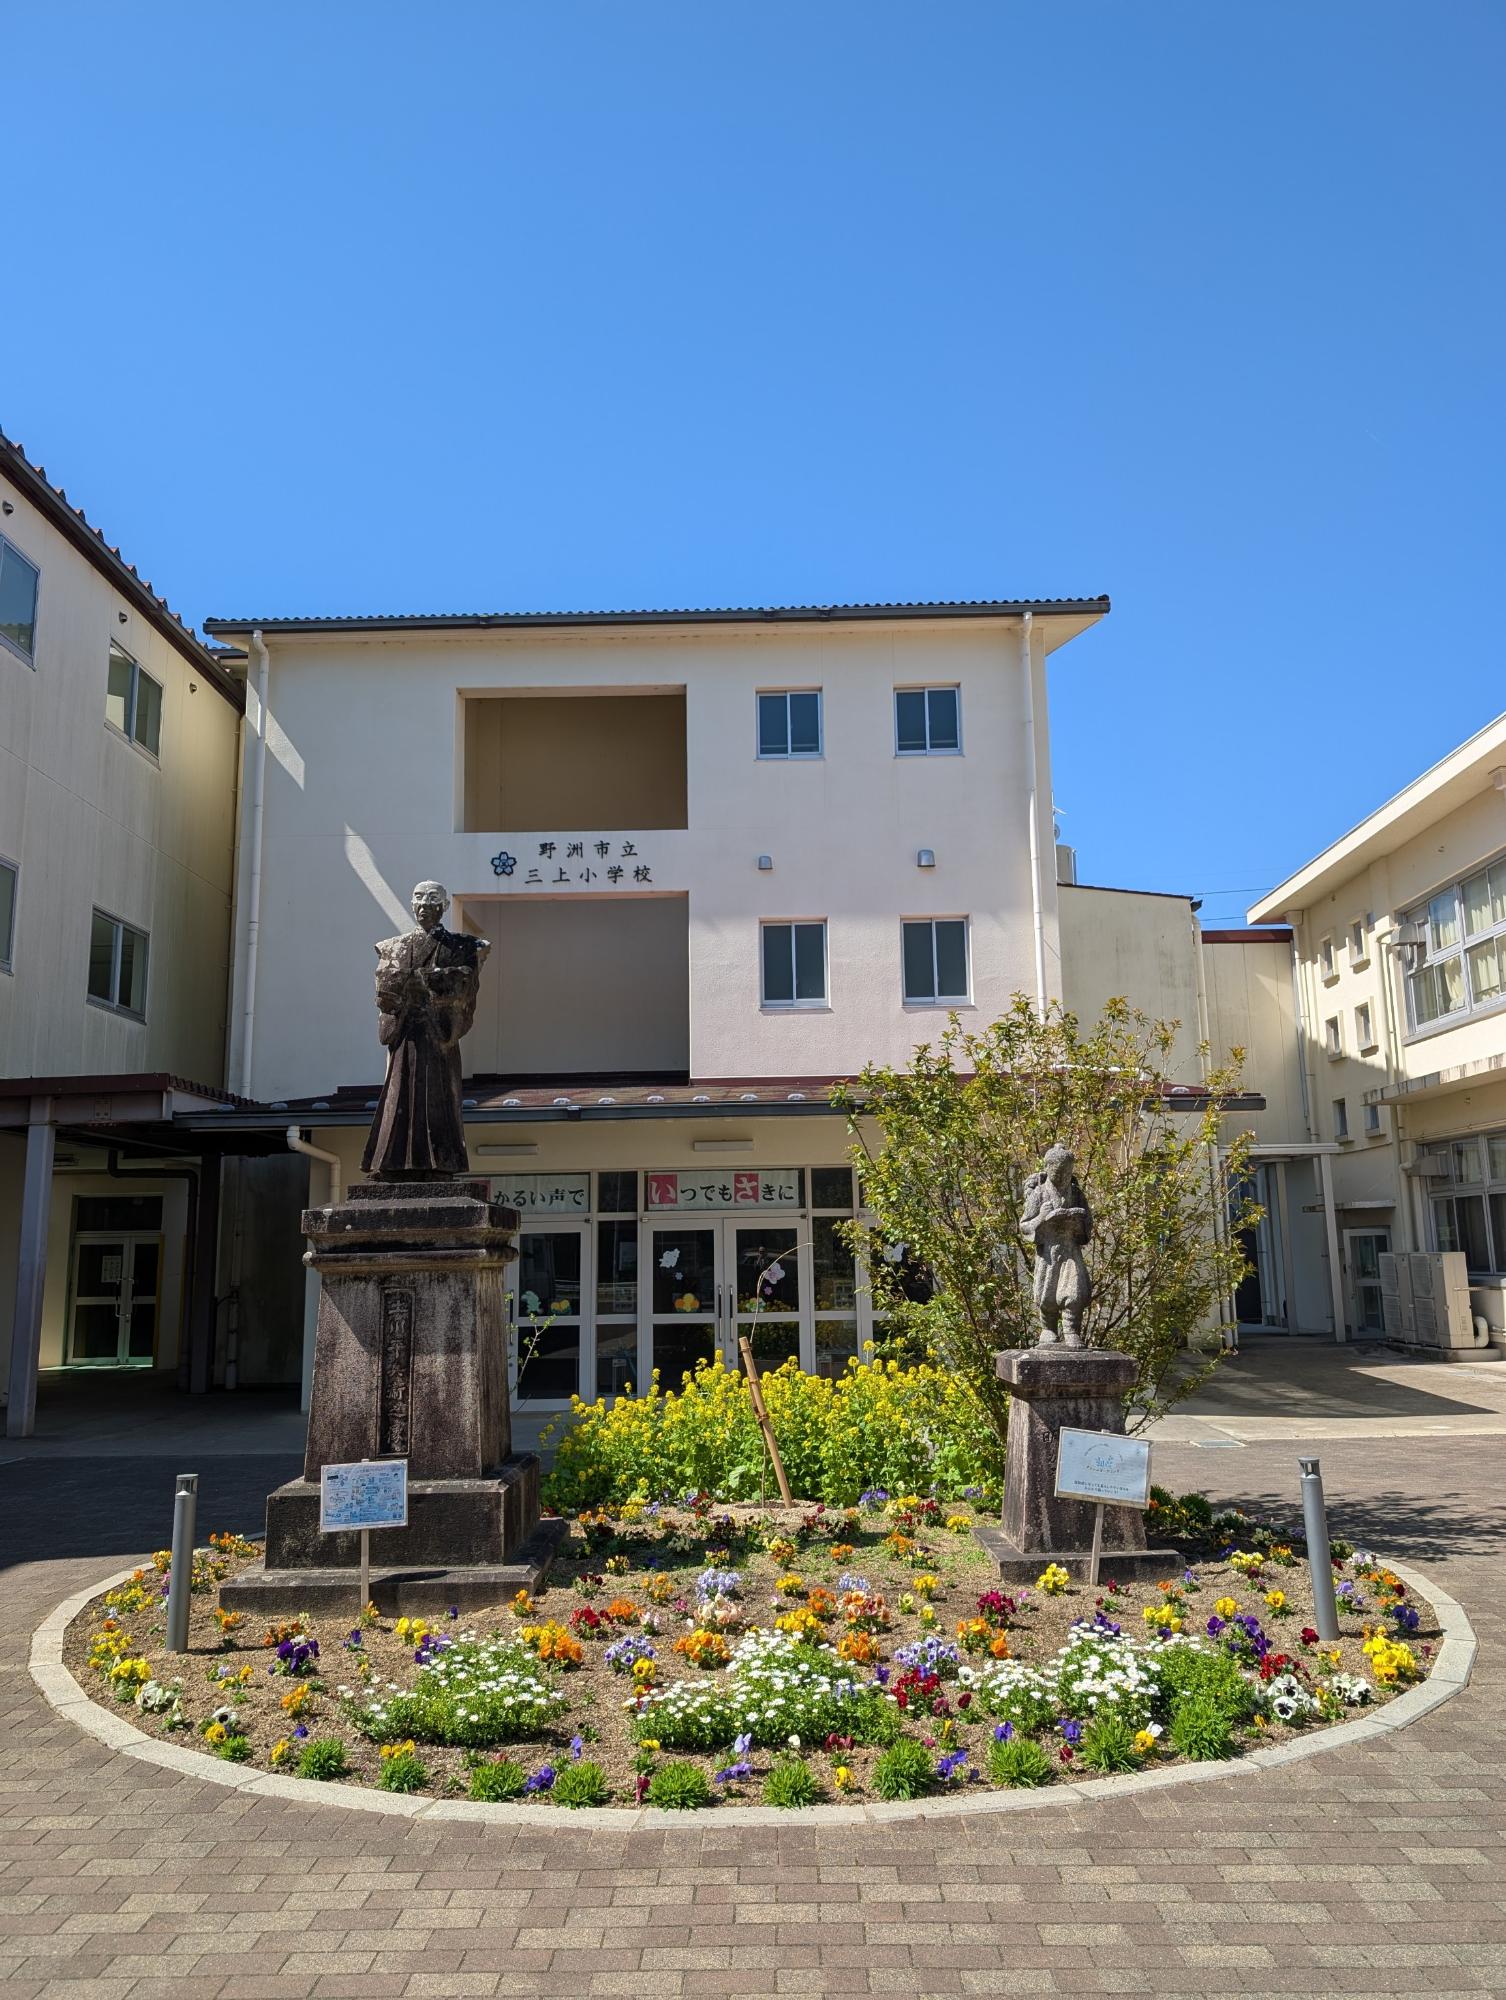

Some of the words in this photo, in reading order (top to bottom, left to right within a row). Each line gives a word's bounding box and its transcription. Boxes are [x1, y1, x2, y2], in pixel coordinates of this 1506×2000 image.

[538, 840, 638, 859] 野洲市立
[524, 865, 653, 884] 三上小学校
[491, 1187, 585, 1207] かるい声で
[649, 1176, 795, 1204] いつでもさきに
